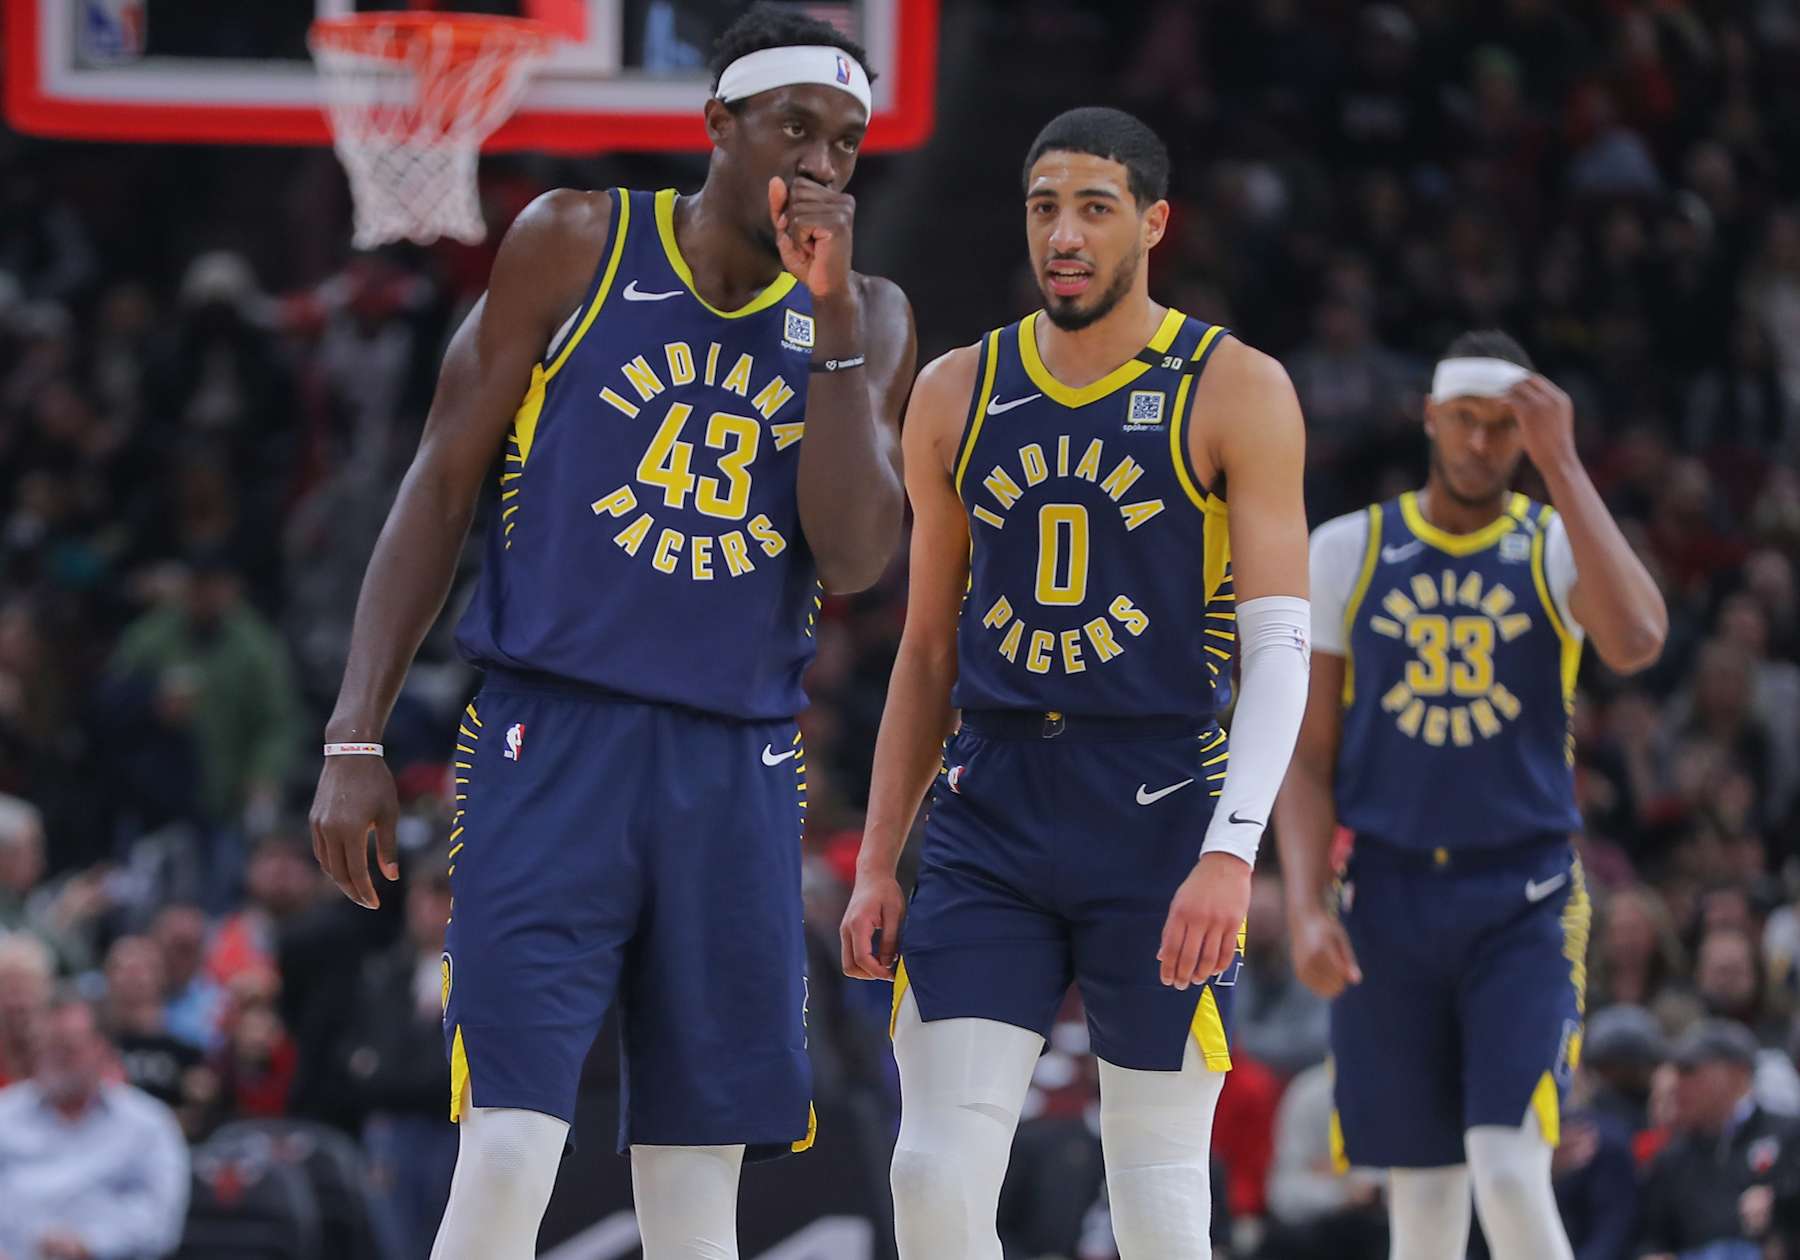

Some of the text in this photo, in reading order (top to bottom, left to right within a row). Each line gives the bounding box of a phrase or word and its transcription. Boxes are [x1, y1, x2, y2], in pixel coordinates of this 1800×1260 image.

[599, 341, 805, 450] INDIANA
[1161, 356, 1183, 371] 30
[636, 401, 761, 520] 43
[973, 435, 1165, 531] INDIANA
[590, 484, 787, 580] PACERS
[1035, 503, 1089, 606] 0
[983, 594, 1150, 674] PACERS
[1370, 569, 1532, 642] INDIANA
[1405, 614, 1495, 696] 33
[1381, 681, 1522, 747] PACERS
